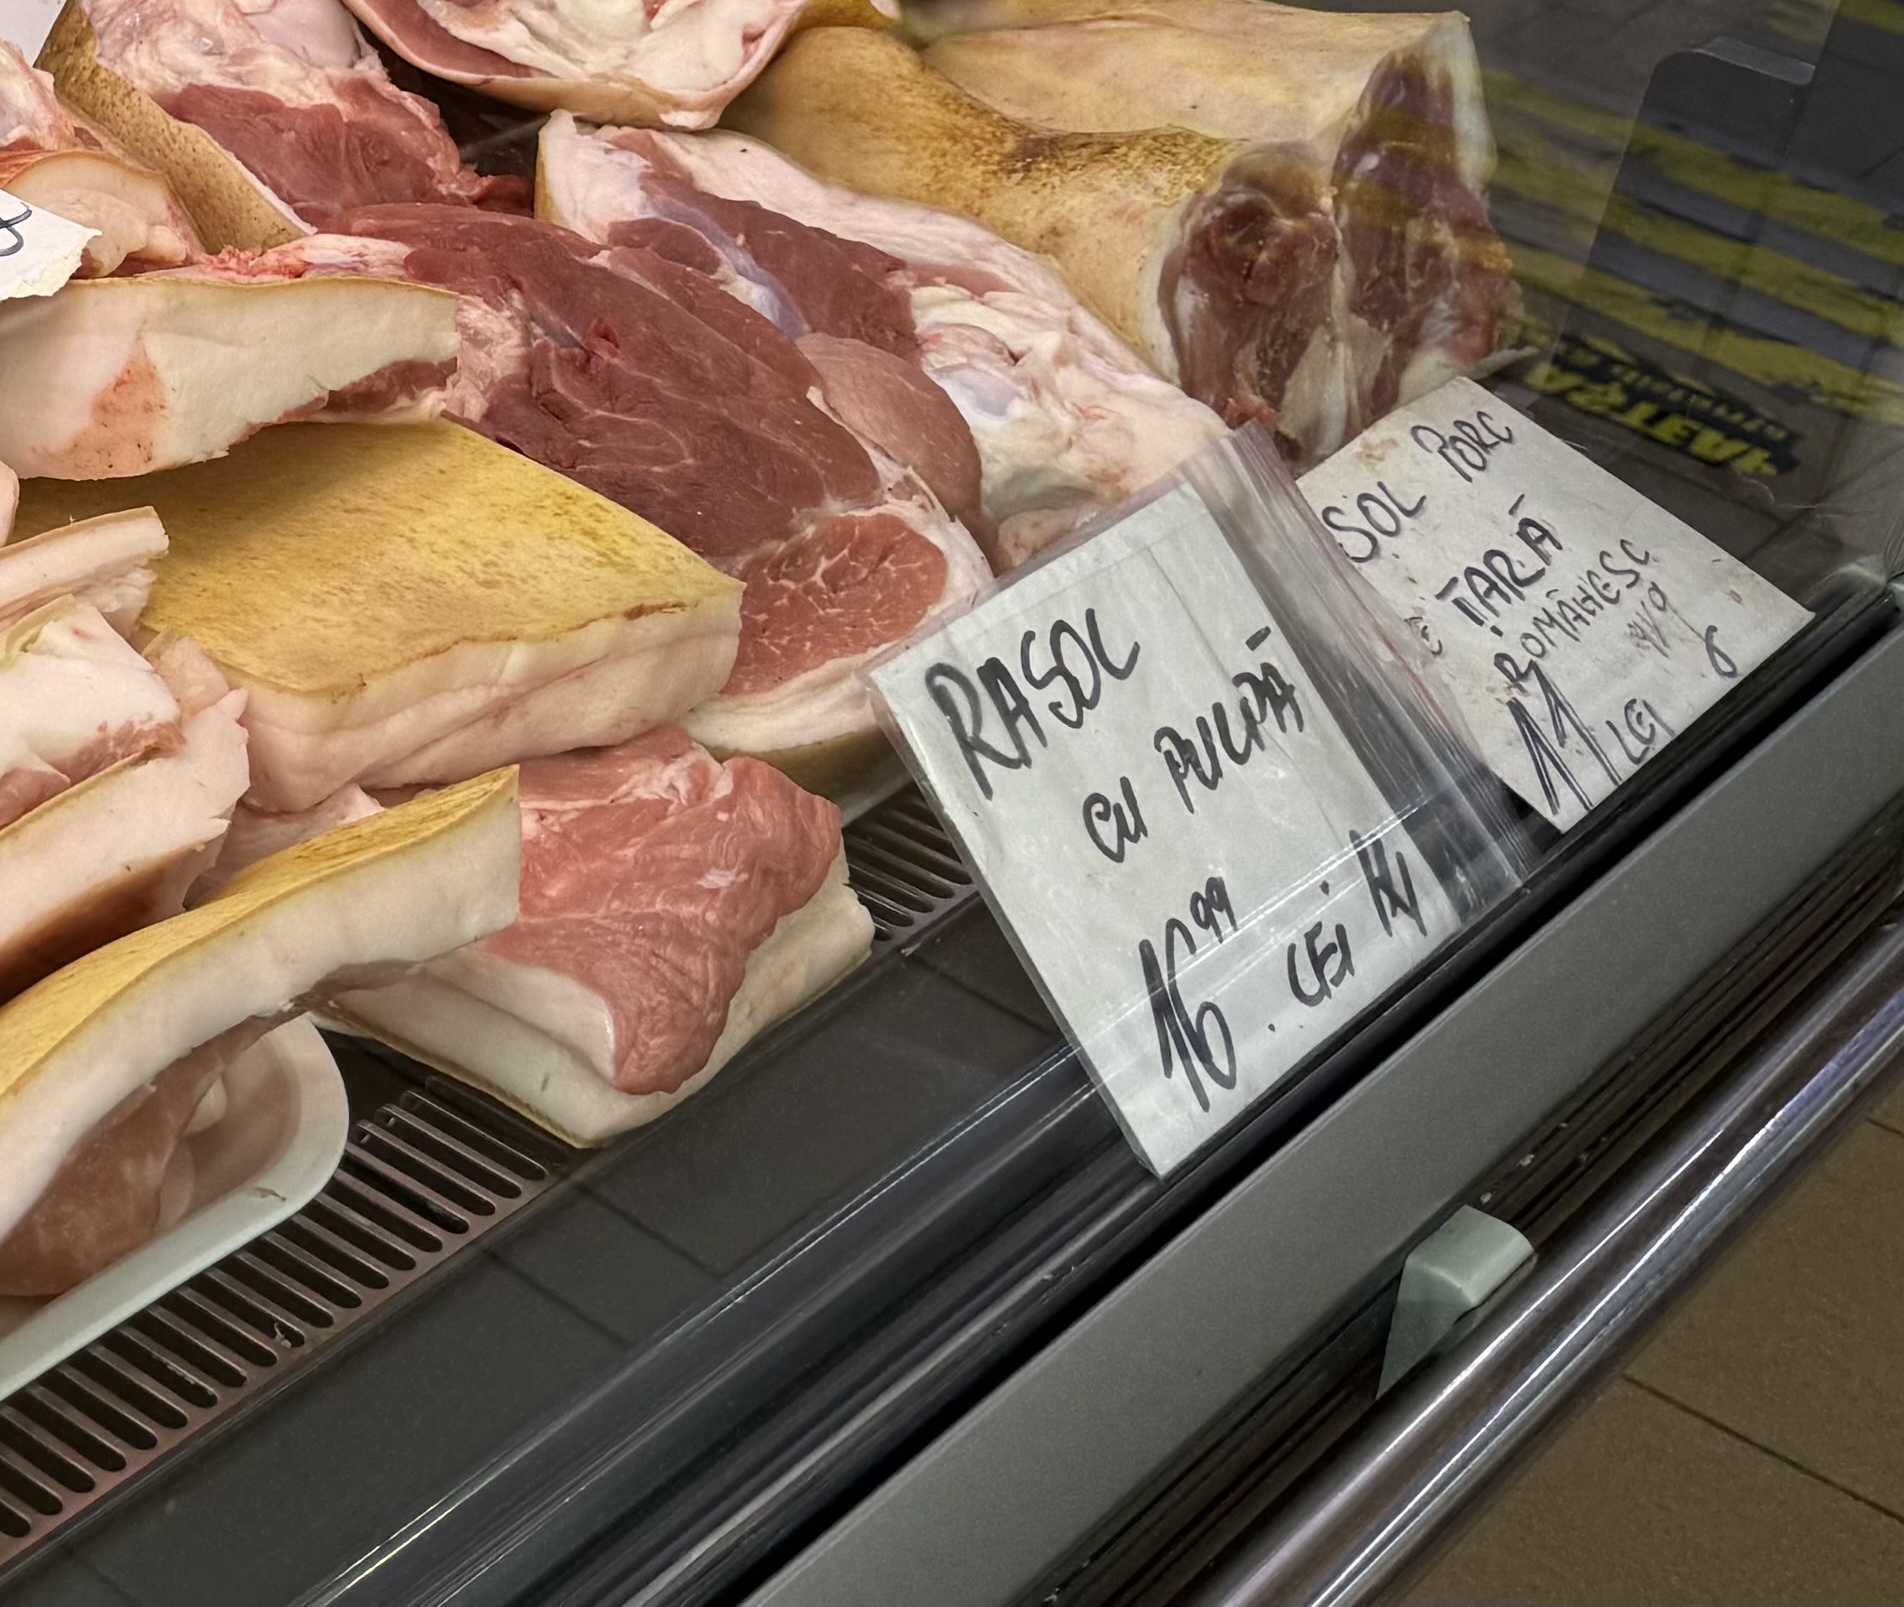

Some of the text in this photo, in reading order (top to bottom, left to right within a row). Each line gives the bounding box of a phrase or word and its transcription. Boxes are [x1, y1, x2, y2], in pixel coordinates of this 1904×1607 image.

[1321, 409, 1515, 565] SOL PORC
[924, 607, 1143, 801] RASOL
[1139, 916, 1238, 1114] 16
